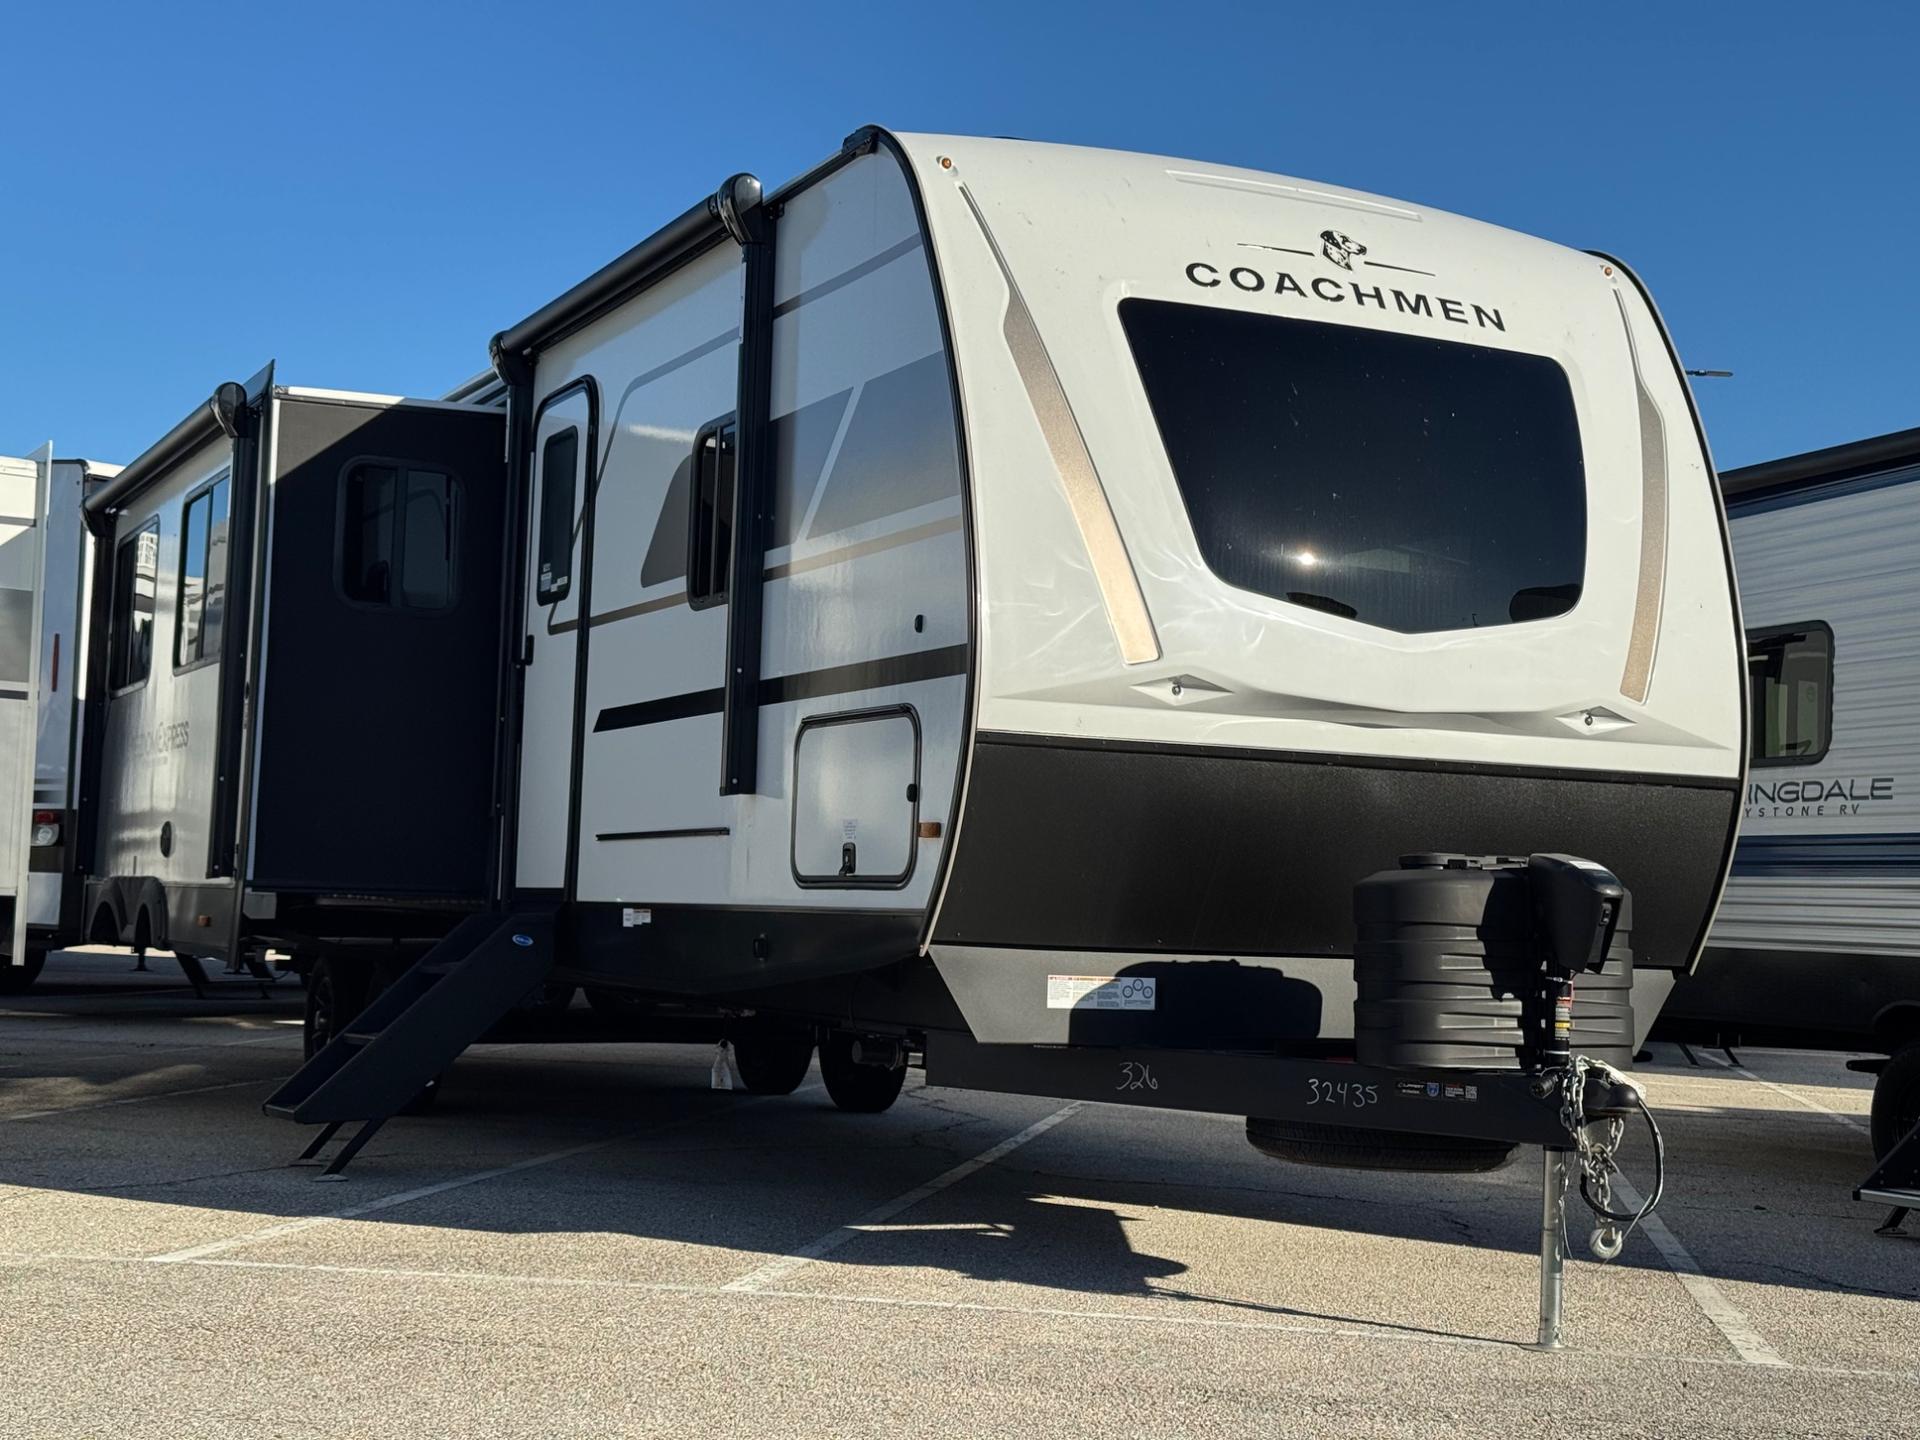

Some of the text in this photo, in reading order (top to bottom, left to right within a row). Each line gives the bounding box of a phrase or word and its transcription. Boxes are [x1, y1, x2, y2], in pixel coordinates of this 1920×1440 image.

[1184, 262, 1506, 332] COACHMEN
[1744, 777, 1894, 805] INGDALE
[1744, 803, 1860, 818] YSTONE RV
[1115, 1061, 1159, 1090] 326
[1306, 1078, 1379, 1108] 32435
